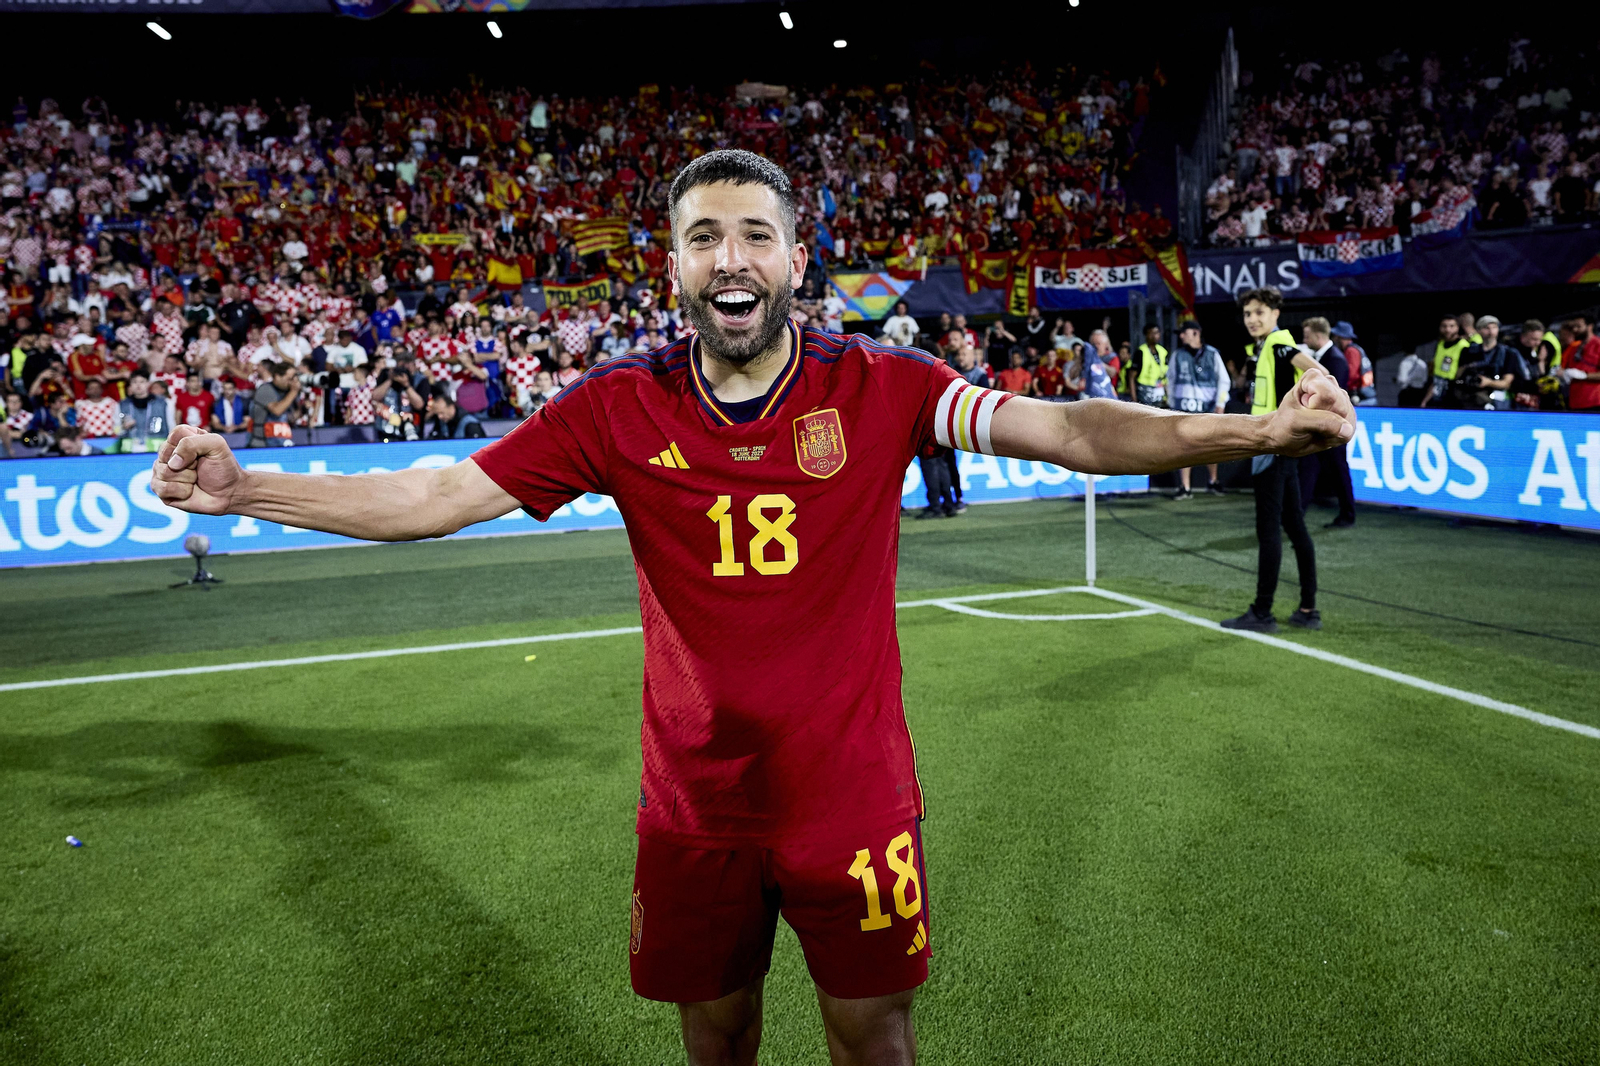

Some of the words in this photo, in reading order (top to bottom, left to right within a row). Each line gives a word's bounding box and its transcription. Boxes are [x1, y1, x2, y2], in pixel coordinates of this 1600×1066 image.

[1188, 259, 1301, 295] INALS
[706, 494, 799, 577] 18
[847, 831, 922, 932] 18
